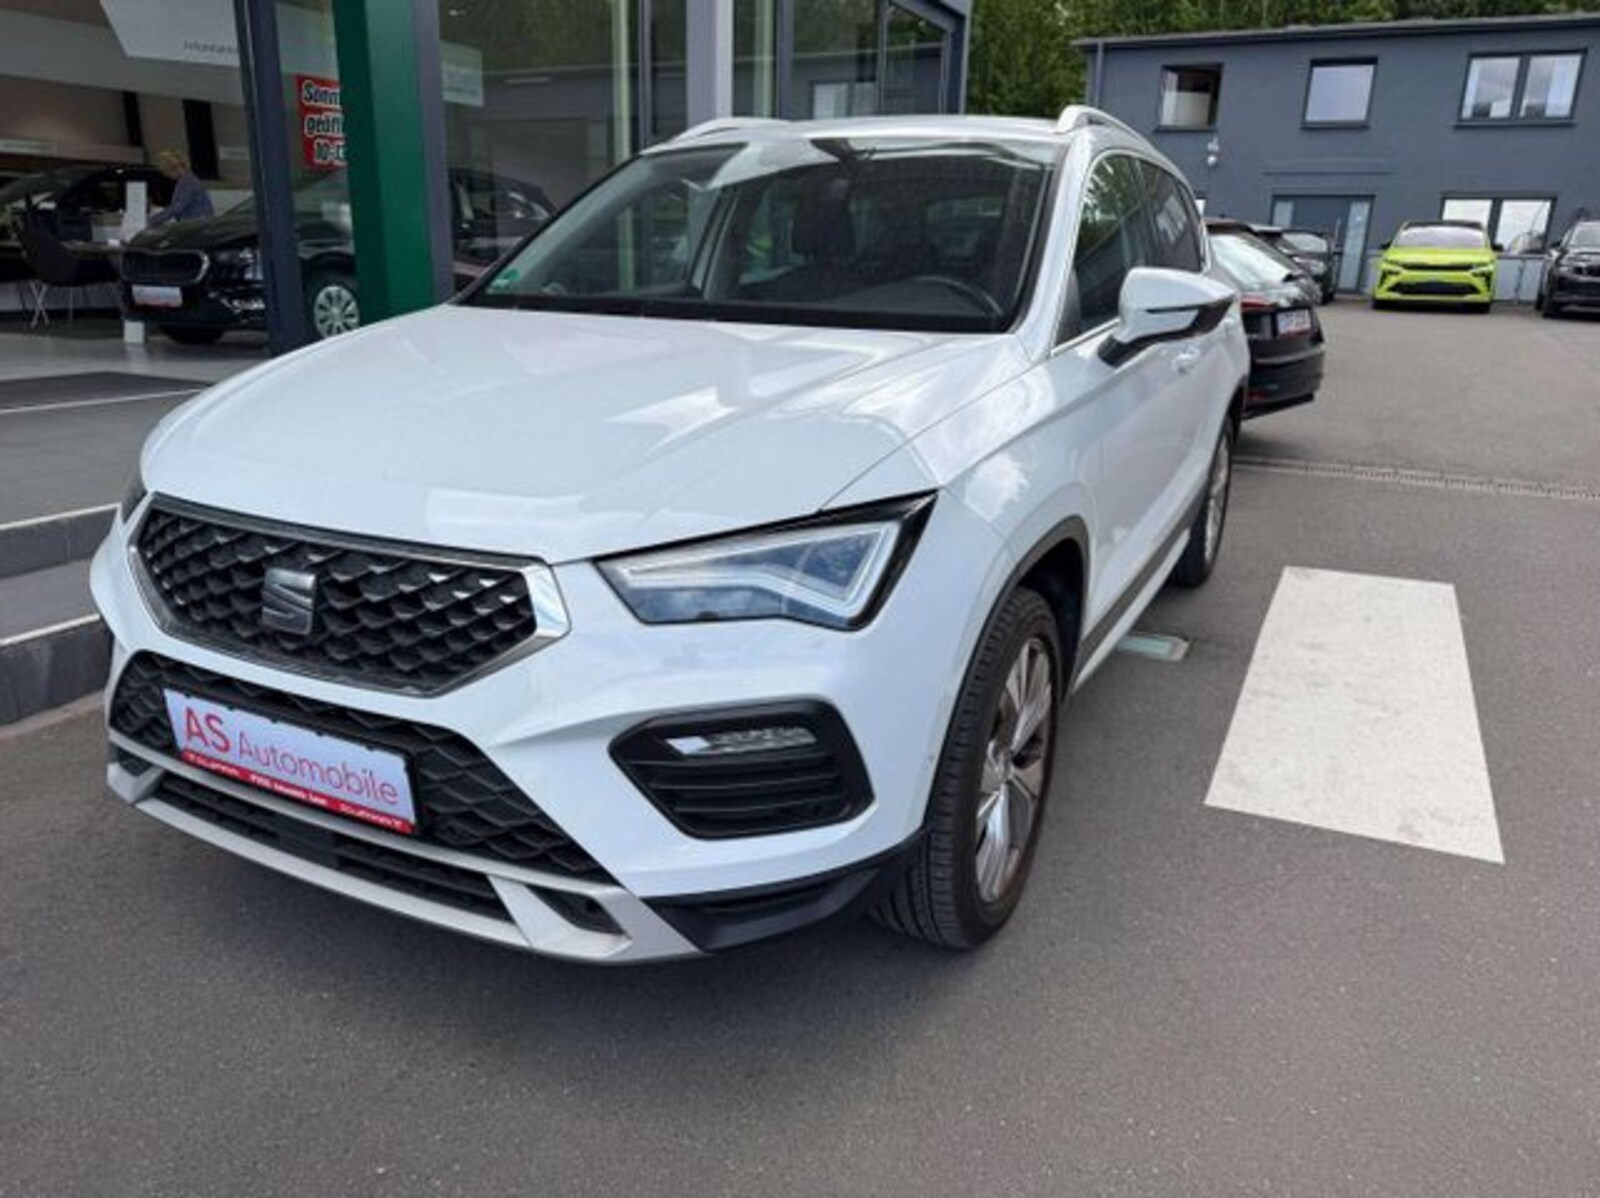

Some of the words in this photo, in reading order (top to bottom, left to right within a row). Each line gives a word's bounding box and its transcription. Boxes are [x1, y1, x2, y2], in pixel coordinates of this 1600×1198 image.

[302, 80, 341, 107] Sonn
[304, 113, 343, 138] geöff
[184, 706, 232, 754] AS
[238, 731, 399, 805] Automobile
